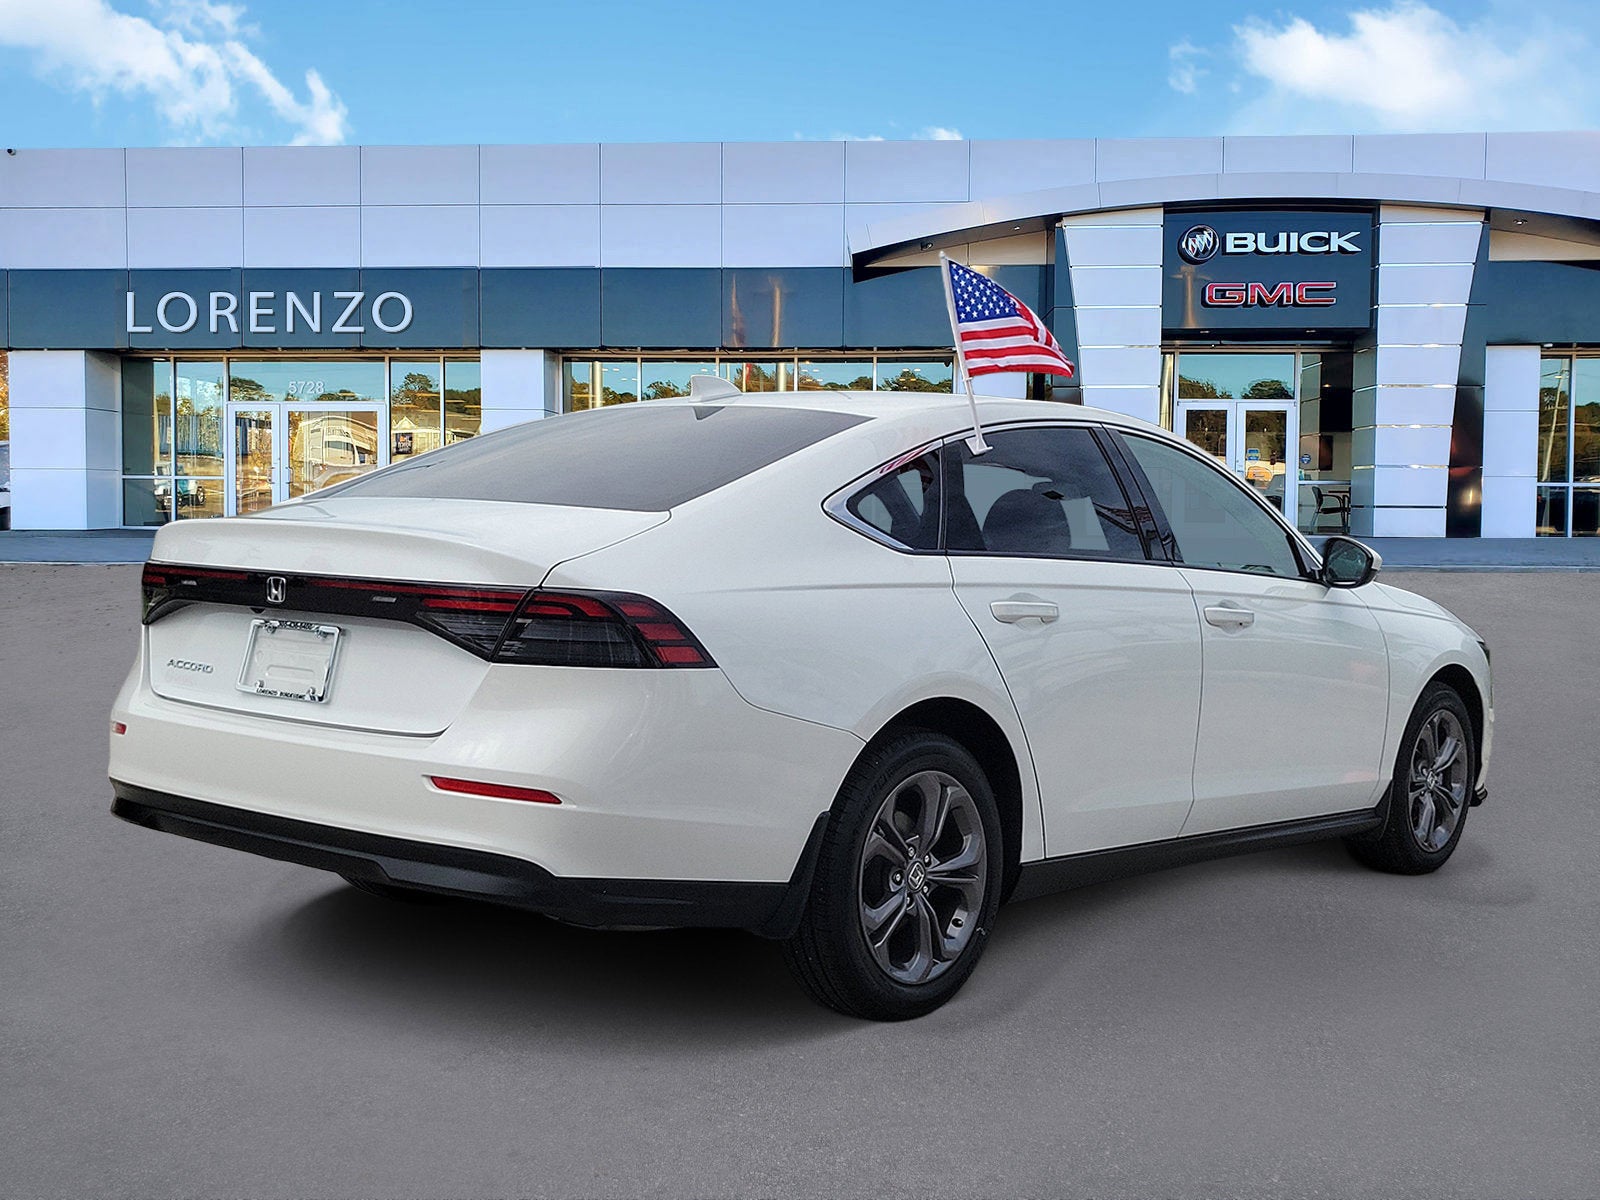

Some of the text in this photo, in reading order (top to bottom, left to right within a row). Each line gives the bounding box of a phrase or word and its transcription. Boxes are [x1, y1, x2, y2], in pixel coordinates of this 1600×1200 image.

[1226, 231, 1362, 253] BUICK
[1206, 281, 1337, 305] GMC
[125, 291, 414, 333] LORENZO
[288, 380, 325, 394] 5728
[167, 659, 214, 674] ACCORD
